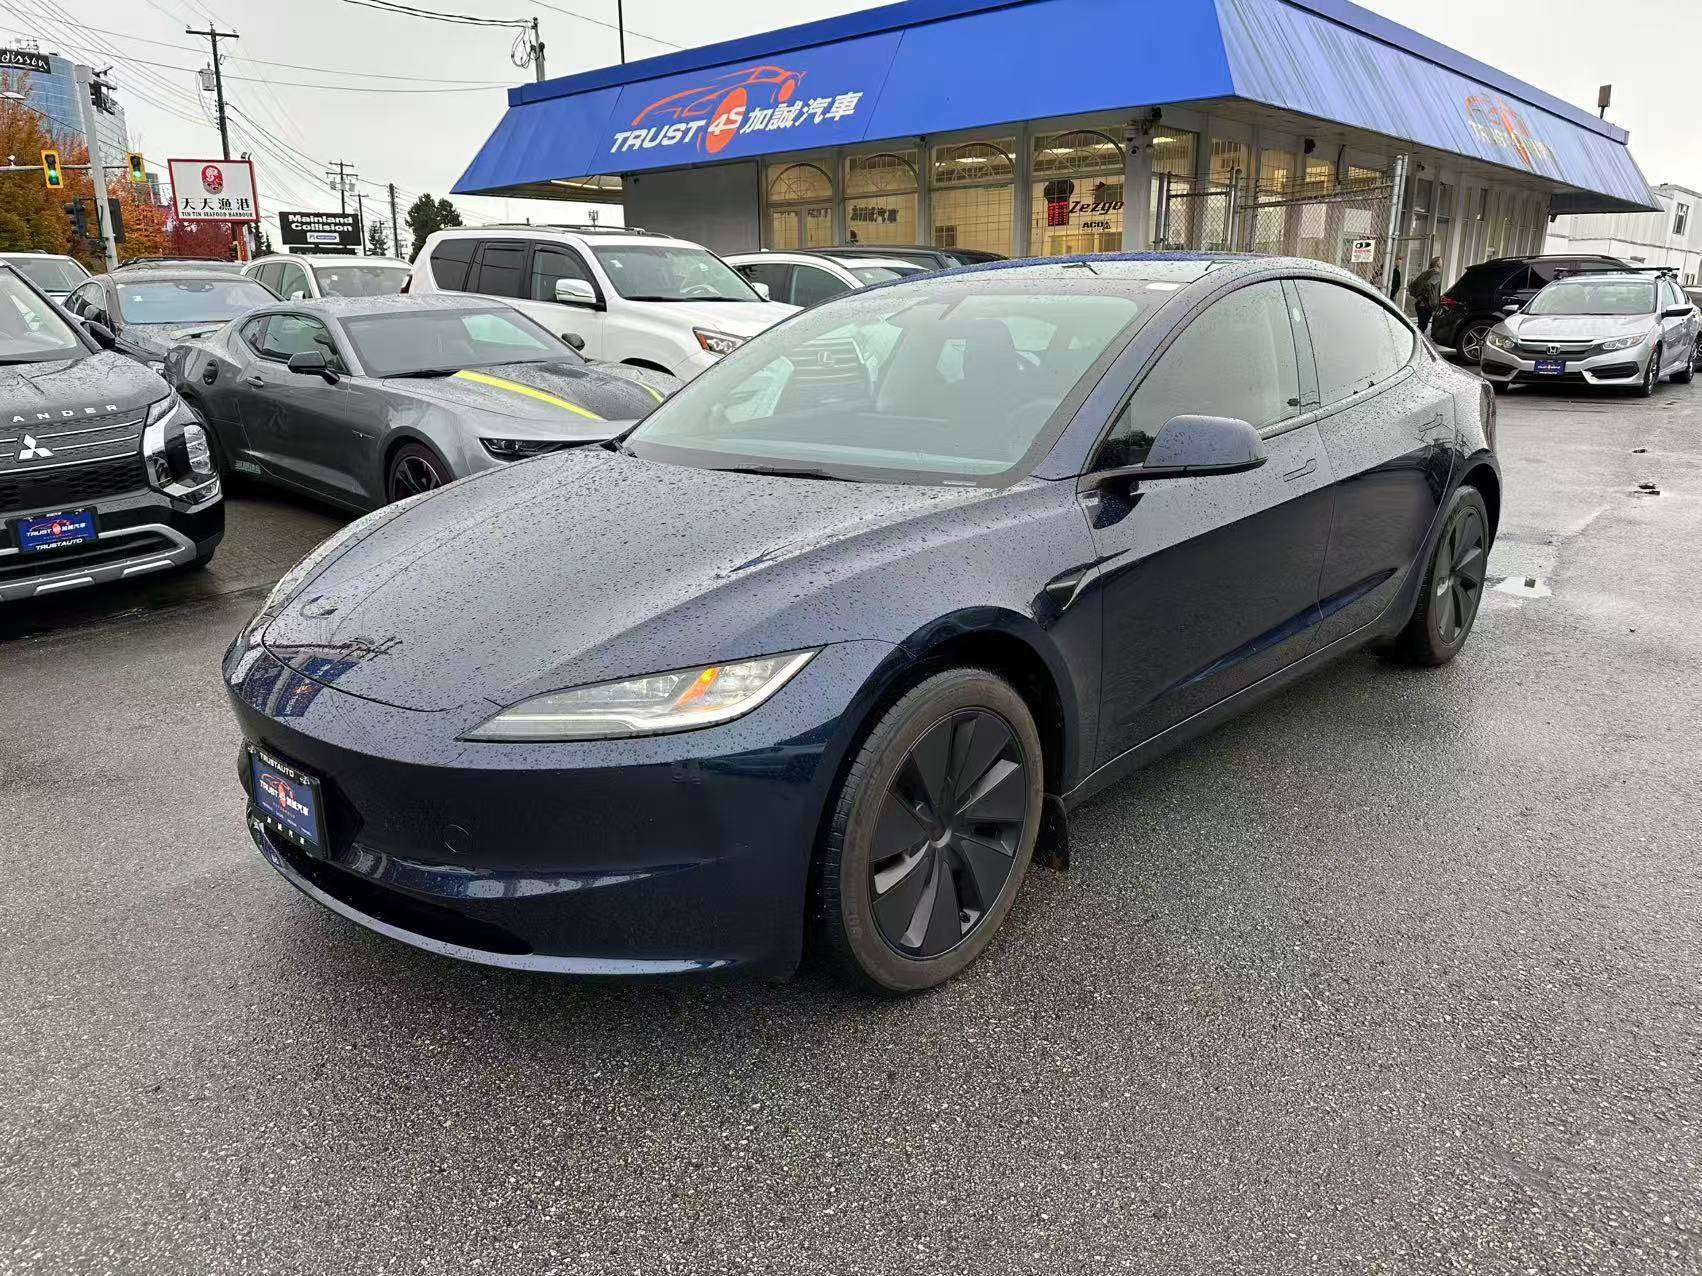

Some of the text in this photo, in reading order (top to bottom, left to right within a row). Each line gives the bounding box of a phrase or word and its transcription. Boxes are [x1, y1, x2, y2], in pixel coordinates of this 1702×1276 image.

[609, 91, 864, 153] TRUST 4S 加誠汽車
[181, 197, 251, 211] 天天漁港
[1069, 200, 1125, 216] Zezgo
[288, 214, 353, 224] Mainland
[290, 223, 353, 232] Collision
[13, 404, 118, 423] ANDER
[26, 528, 52, 537] TRUST
[35, 538, 83, 550] TRUSTAUTO
[259, 751, 295, 778] TRUSTAUTO
